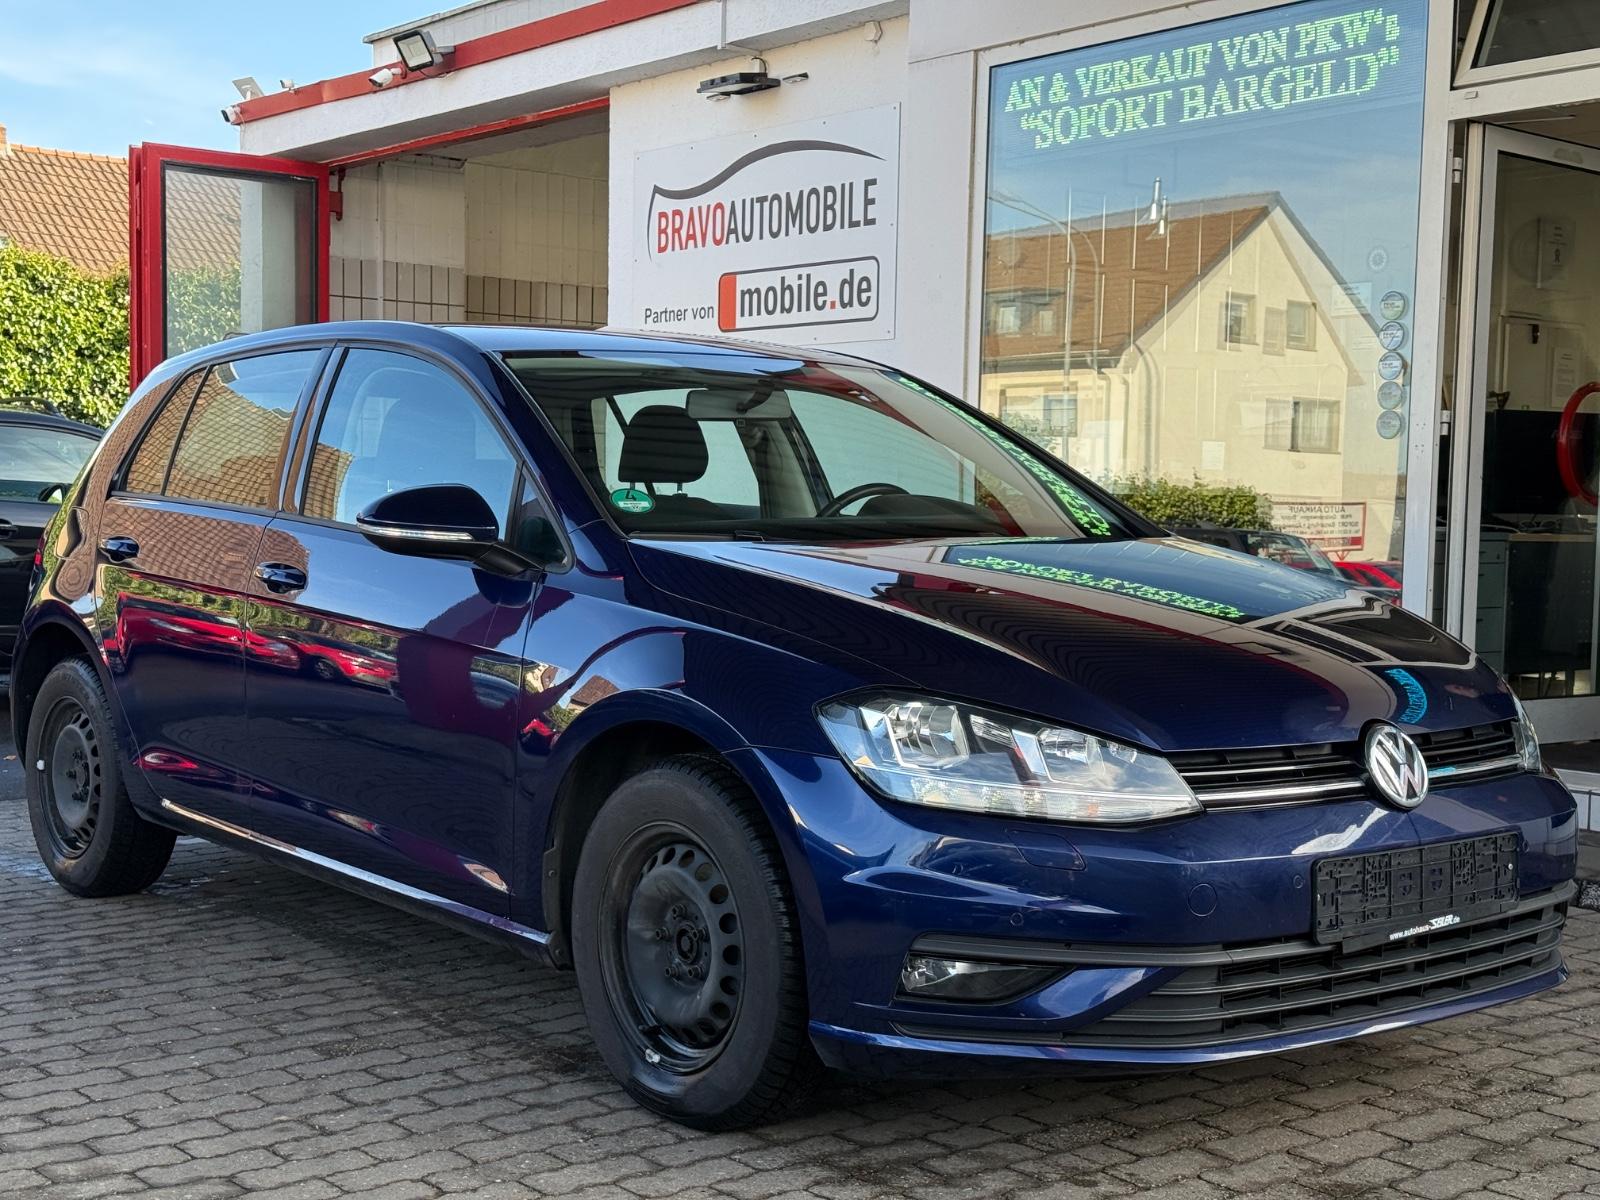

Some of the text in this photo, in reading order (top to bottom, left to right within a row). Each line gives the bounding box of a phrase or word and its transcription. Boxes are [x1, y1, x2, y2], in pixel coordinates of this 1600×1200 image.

[1004, 76, 1045, 113] AN
[1049, 72, 1071, 104] &
[1075, 42, 1213, 98] VERKAUF
[1217, 27, 1291, 71] VON
[657, 178, 878, 253] BRAVOAUTOMOBILE
[644, 304, 715, 324] Partner von
[740, 268, 872, 318] mobile.de
